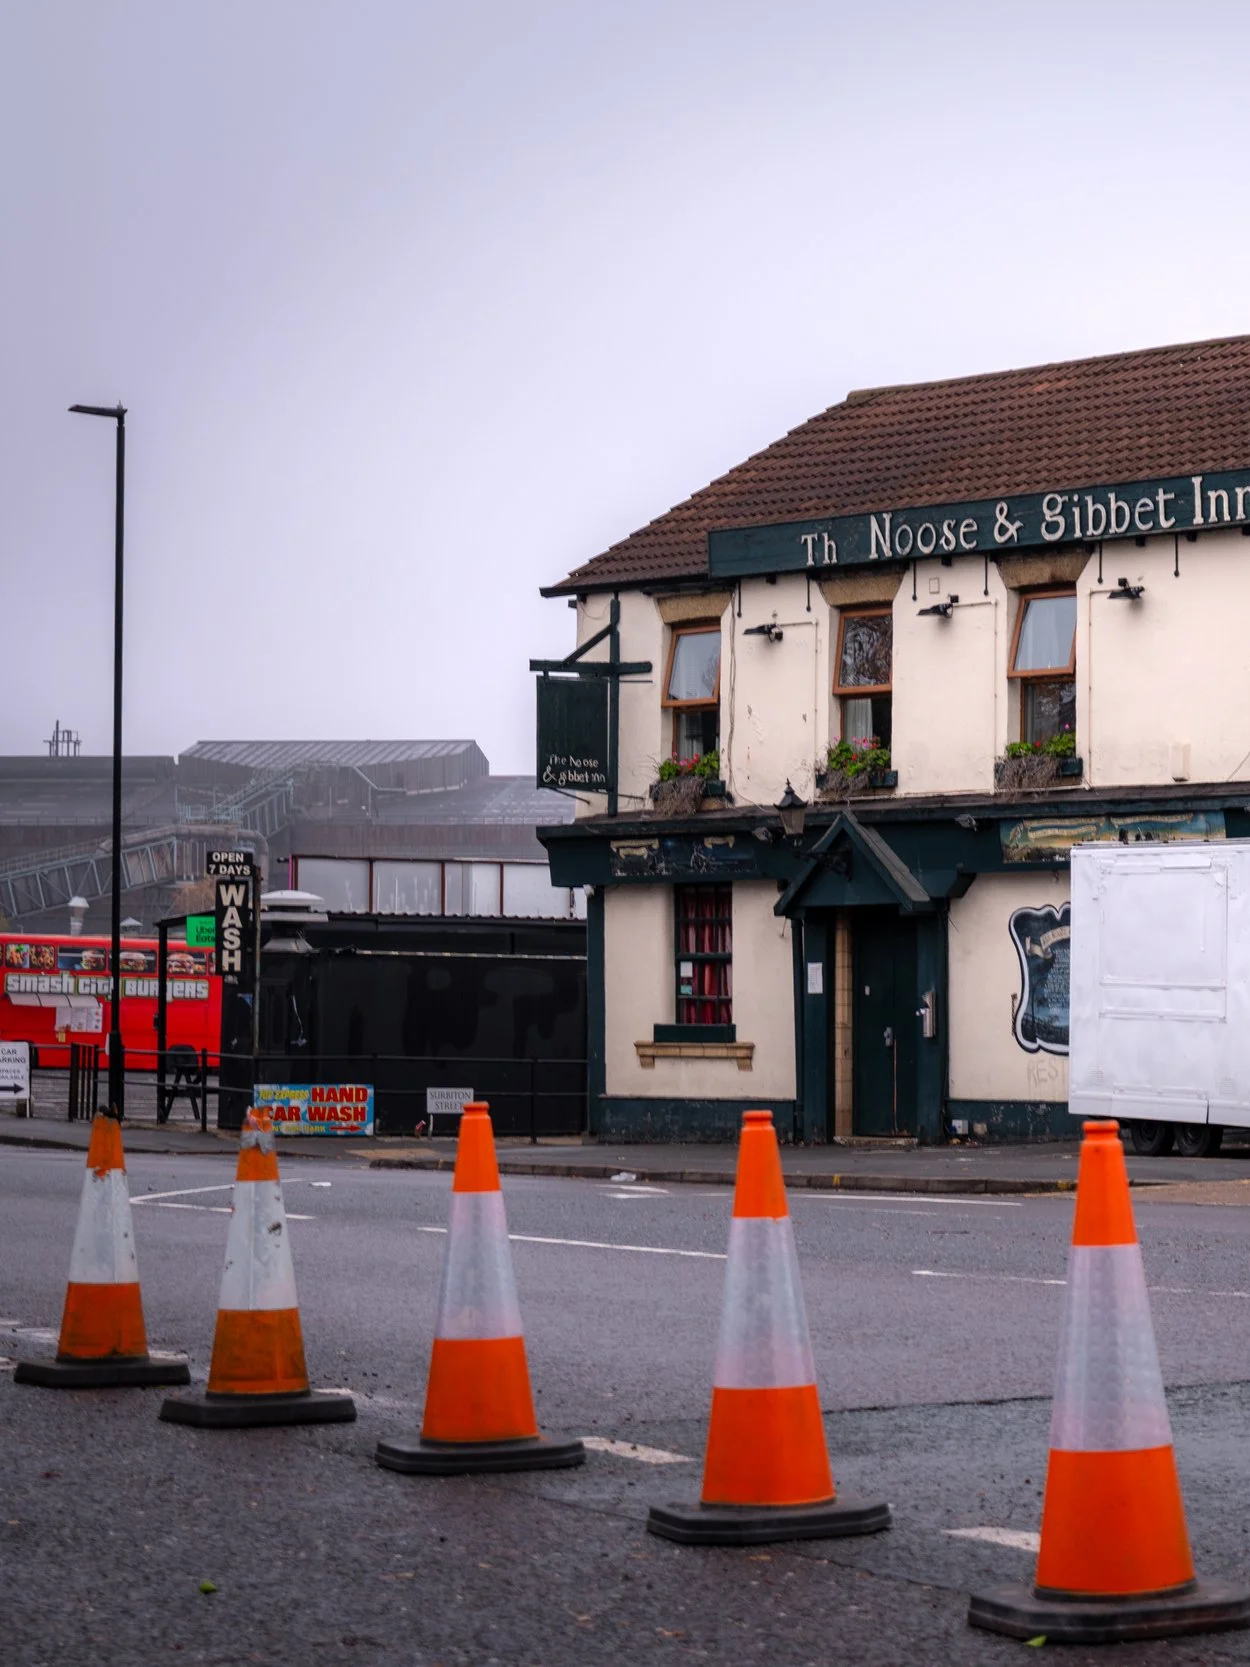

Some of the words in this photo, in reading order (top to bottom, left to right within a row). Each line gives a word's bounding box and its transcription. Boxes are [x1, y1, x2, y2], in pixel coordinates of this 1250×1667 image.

[801, 533, 838, 566] Th
[869, 512, 978, 560] Noose
[993, 501, 1024, 544] &
[569, 755, 599, 768] Noose
[543, 765, 557, 783] &
[212, 852, 244, 862] OPEN
[209, 864, 215, 874] 7
[219, 864, 251, 876] DAYS
[220, 884, 246, 972] WASH
[311, 1087, 368, 1102] HAND
[430, 1091, 471, 1100] SURBITON
[308, 1106, 366, 1122] WASH
